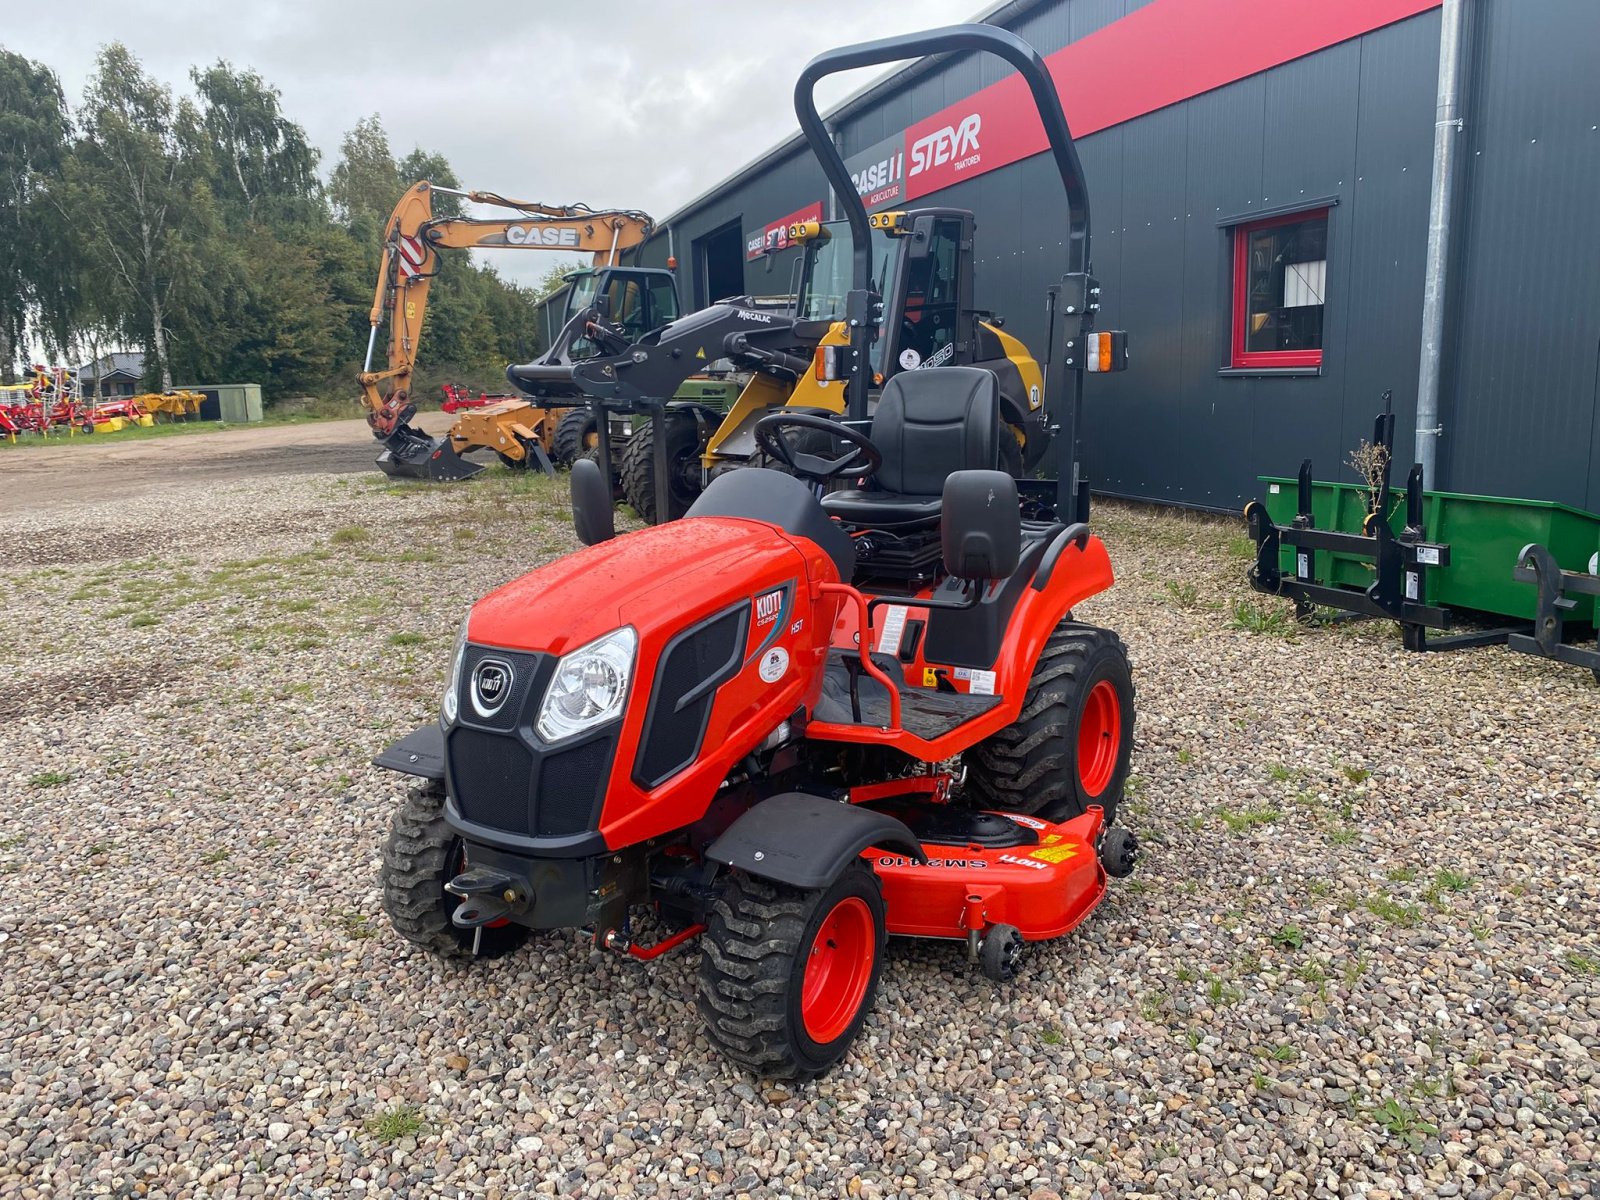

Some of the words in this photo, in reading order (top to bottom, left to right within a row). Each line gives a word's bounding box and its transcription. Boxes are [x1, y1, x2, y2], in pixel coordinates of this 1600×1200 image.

[909, 113, 982, 177] STEYR
[954, 153, 981, 171] TRAKTOREN
[850, 159, 888, 196] CASE
[870, 185, 899, 205] AGRICULTURE
[506, 225, 577, 246] CASE
[757, 590, 783, 620] KIOTI
[791, 618, 804, 635] HST
[998, 854, 1048, 870] KIOTI
